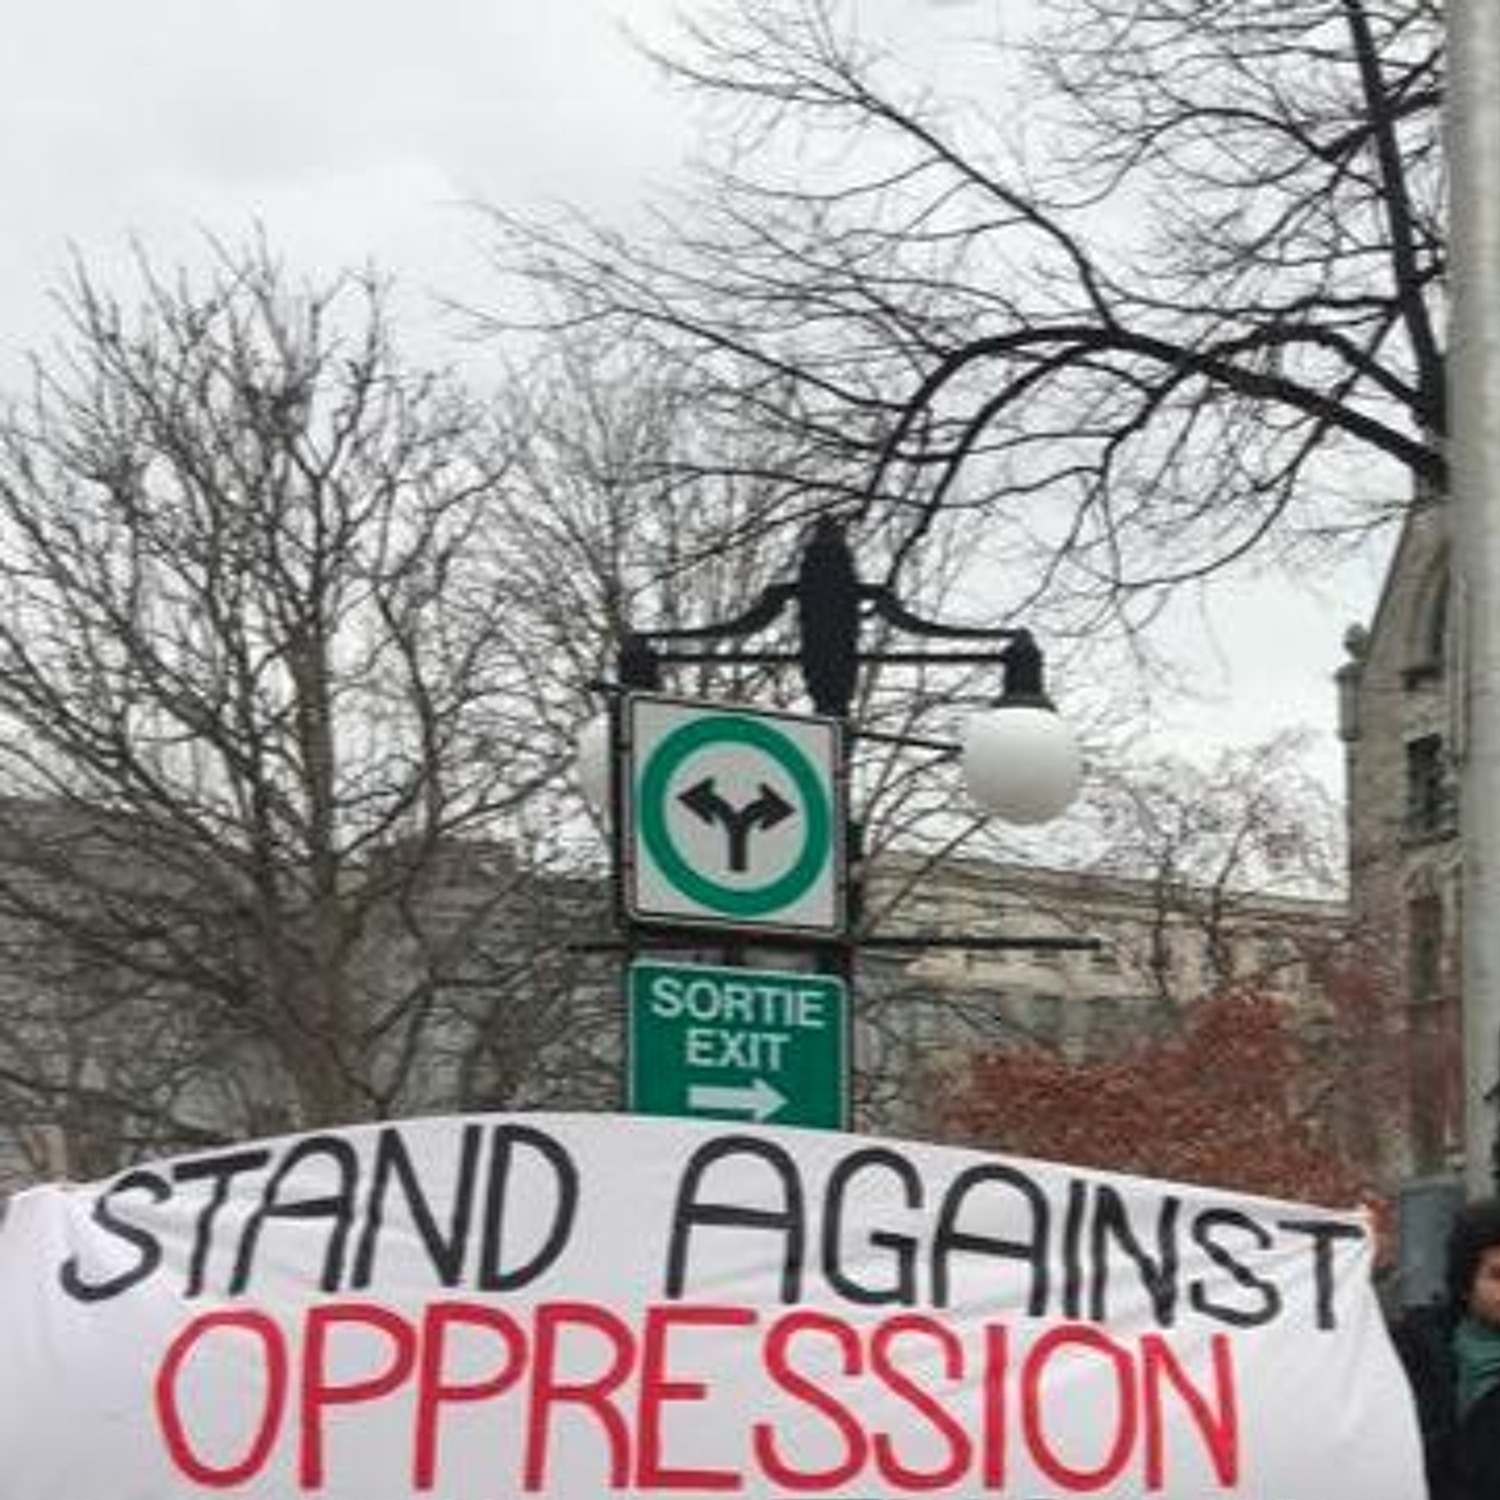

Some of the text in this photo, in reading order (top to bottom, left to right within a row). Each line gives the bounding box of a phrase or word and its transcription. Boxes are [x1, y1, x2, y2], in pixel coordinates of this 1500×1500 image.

[650, 977, 827, 1029] SORTIE
[684, 1027, 790, 1071] EXIT
[60, 1124, 1366, 1330] STAND AGAINST
[154, 1302, 1239, 1493] OPPRESSION
